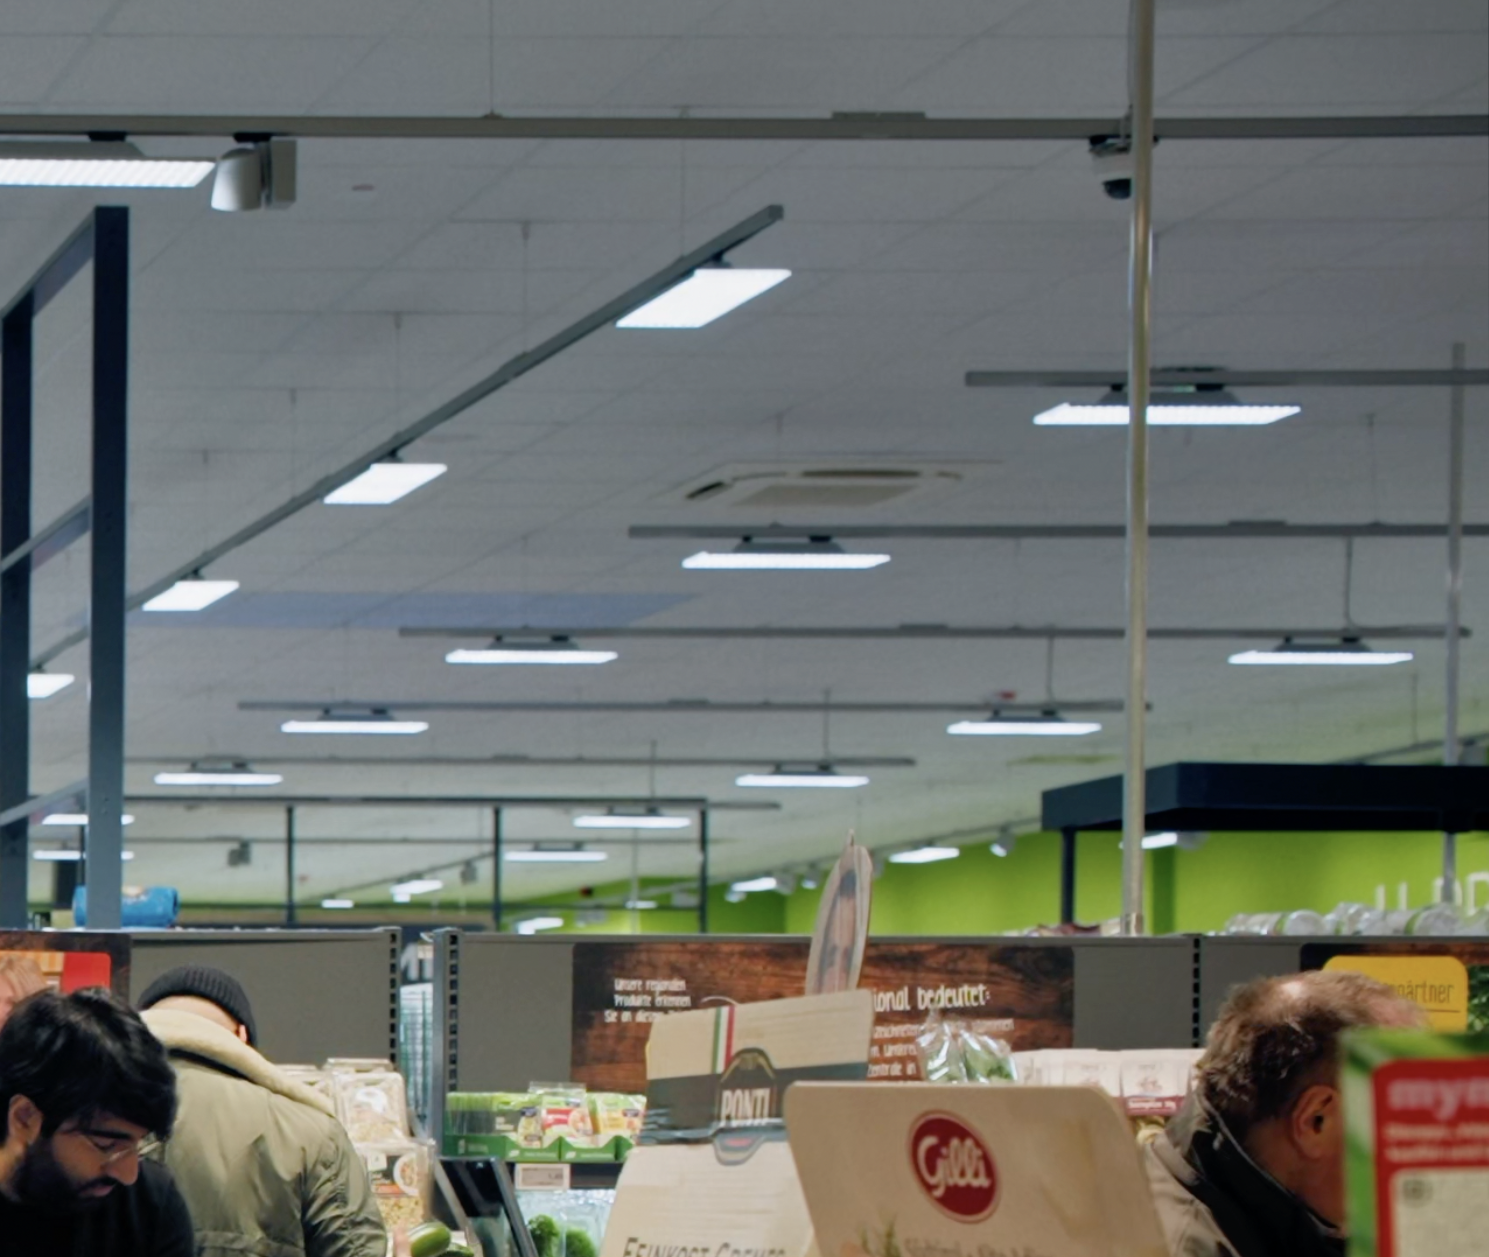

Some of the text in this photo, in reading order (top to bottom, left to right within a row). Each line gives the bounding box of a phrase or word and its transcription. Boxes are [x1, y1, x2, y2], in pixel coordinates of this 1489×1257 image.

[1383, 979, 1455, 1004] gärtner
[721, 1087, 771, 1123] PONTI
[917, 1135, 992, 1198] Gilli
